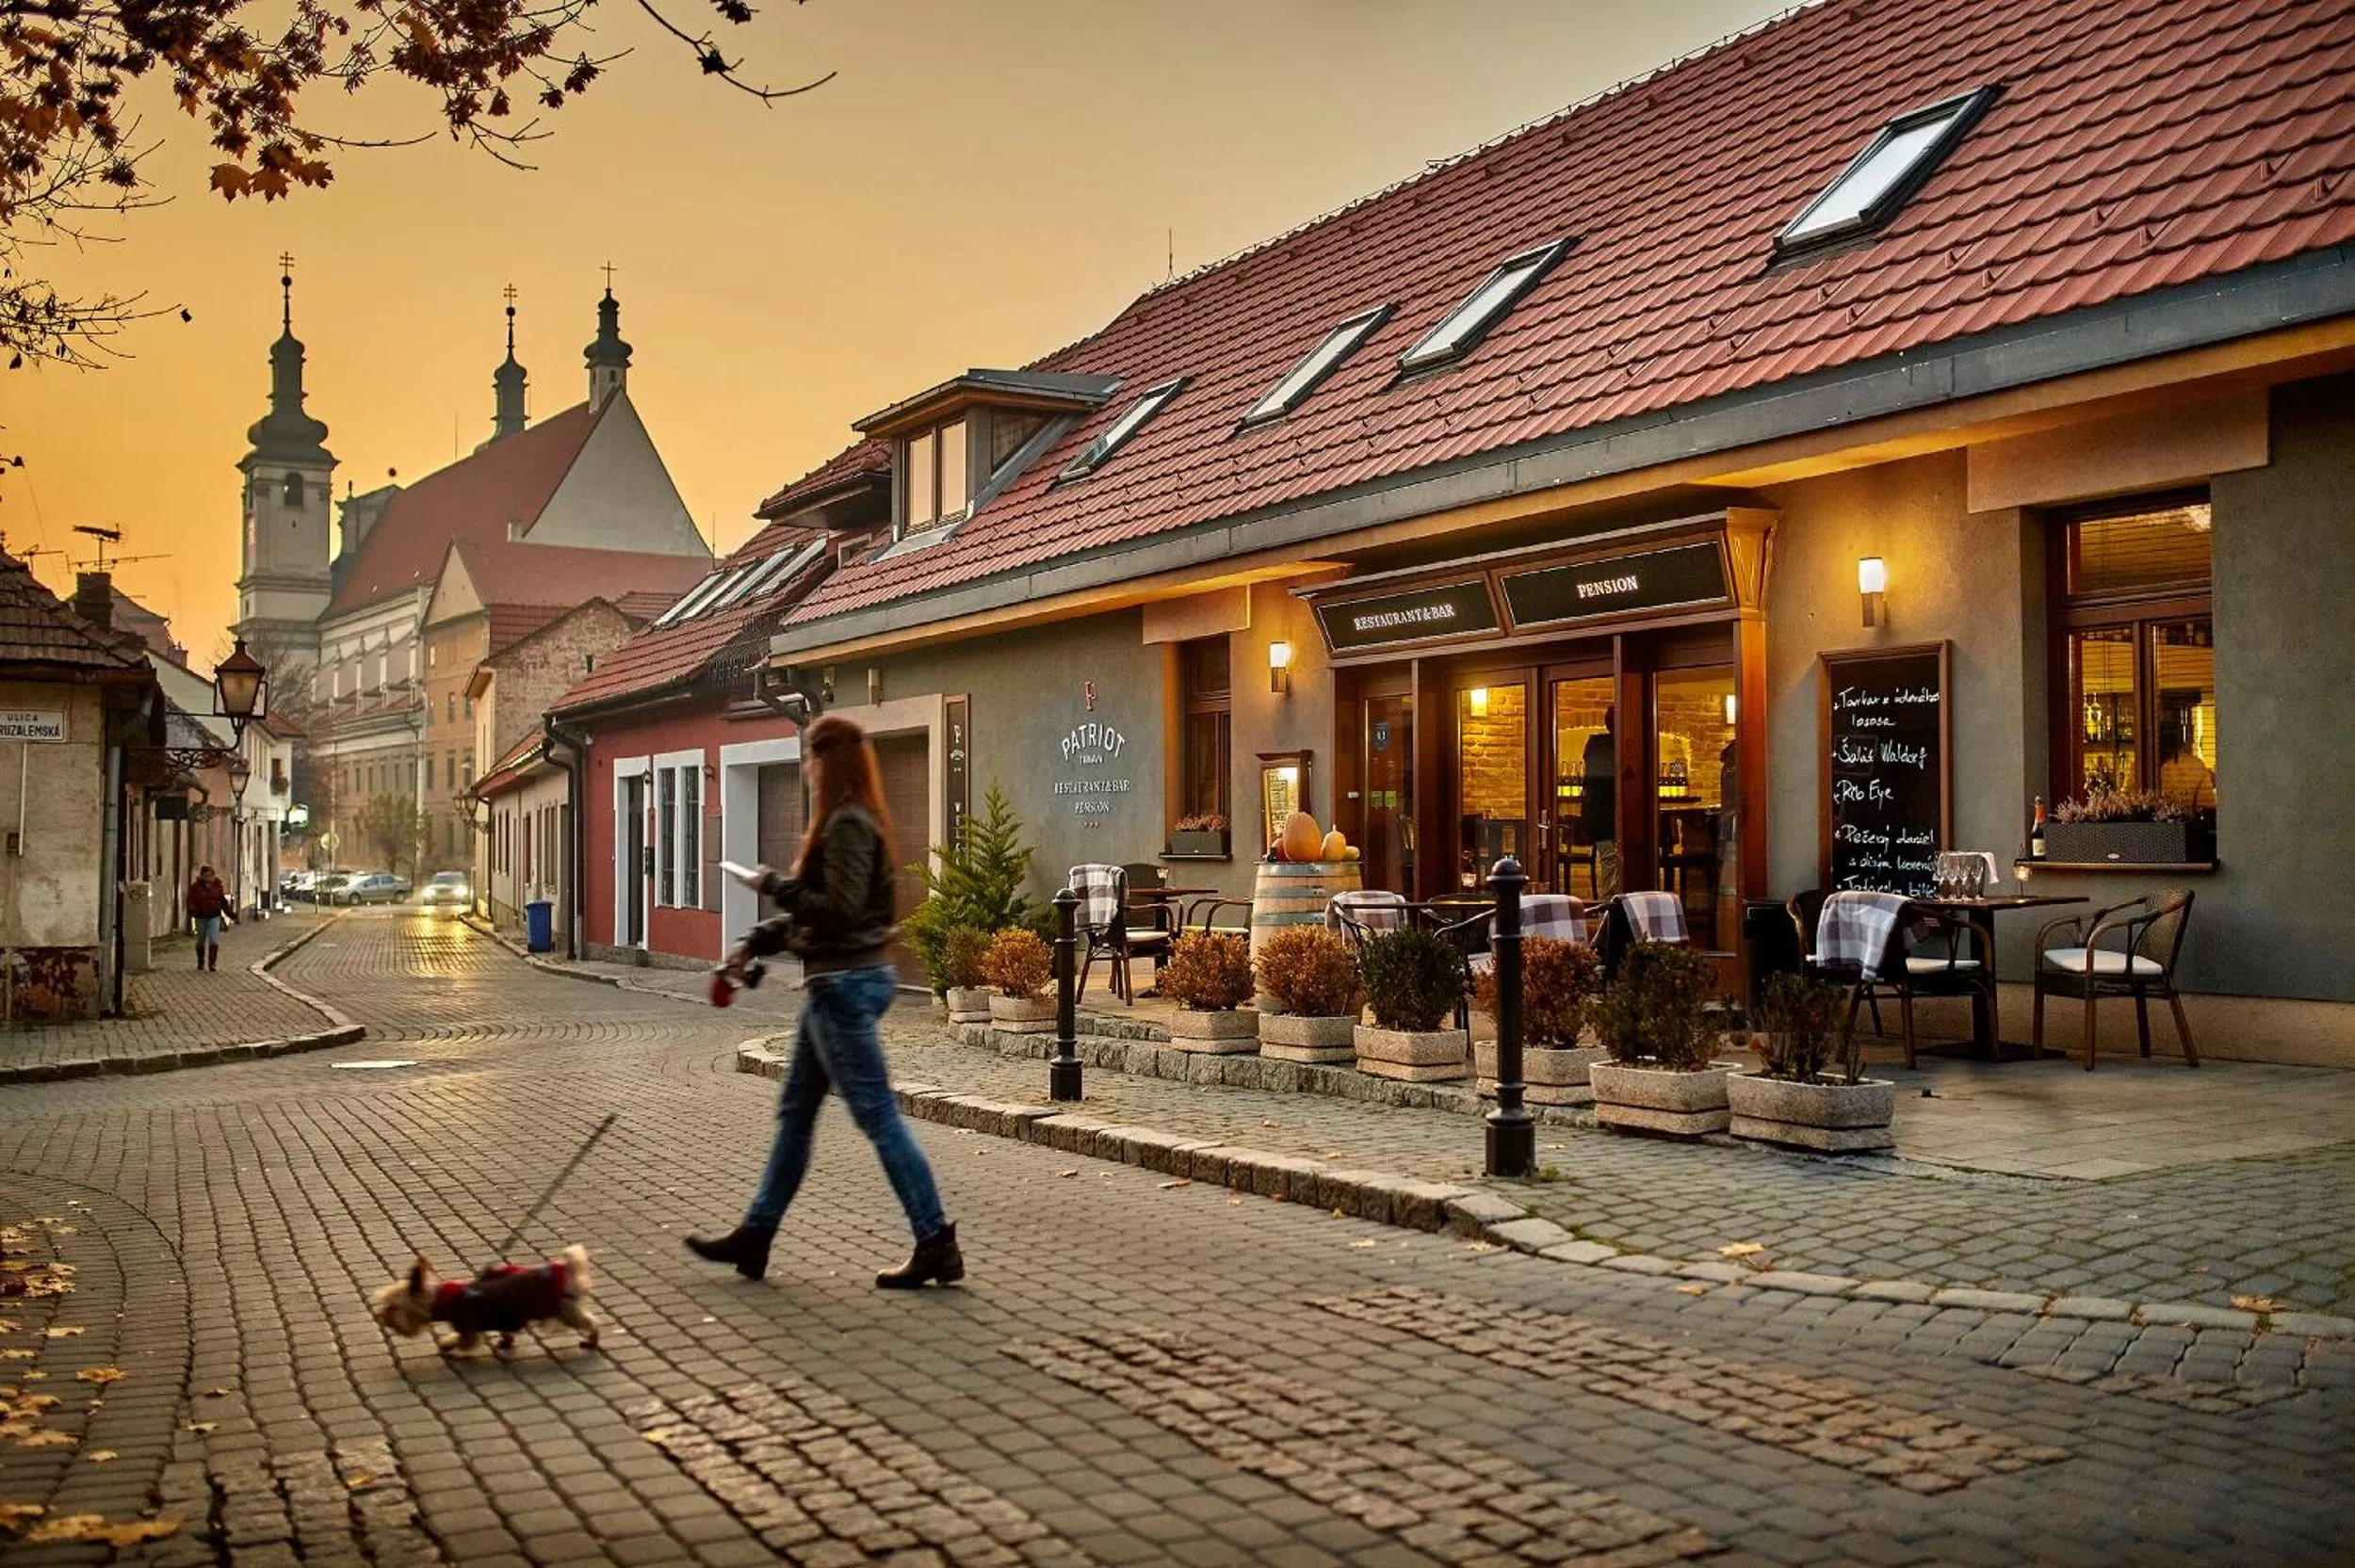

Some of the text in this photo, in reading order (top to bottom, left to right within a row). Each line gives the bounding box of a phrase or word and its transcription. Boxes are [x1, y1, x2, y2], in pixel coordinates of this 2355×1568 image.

[1577, 575, 1639, 599] PENSION
[1354, 603, 1455, 630] RESTAURANT&BAR
[1062, 722, 1125, 761] PATRIOT
[1880, 739, 1927, 770] Waldorf
[1054, 779, 1130, 794] RESTAURANT&BAR
[1869, 778, 1893, 810] Eye
[1074, 800, 1110, 814] PENSION
